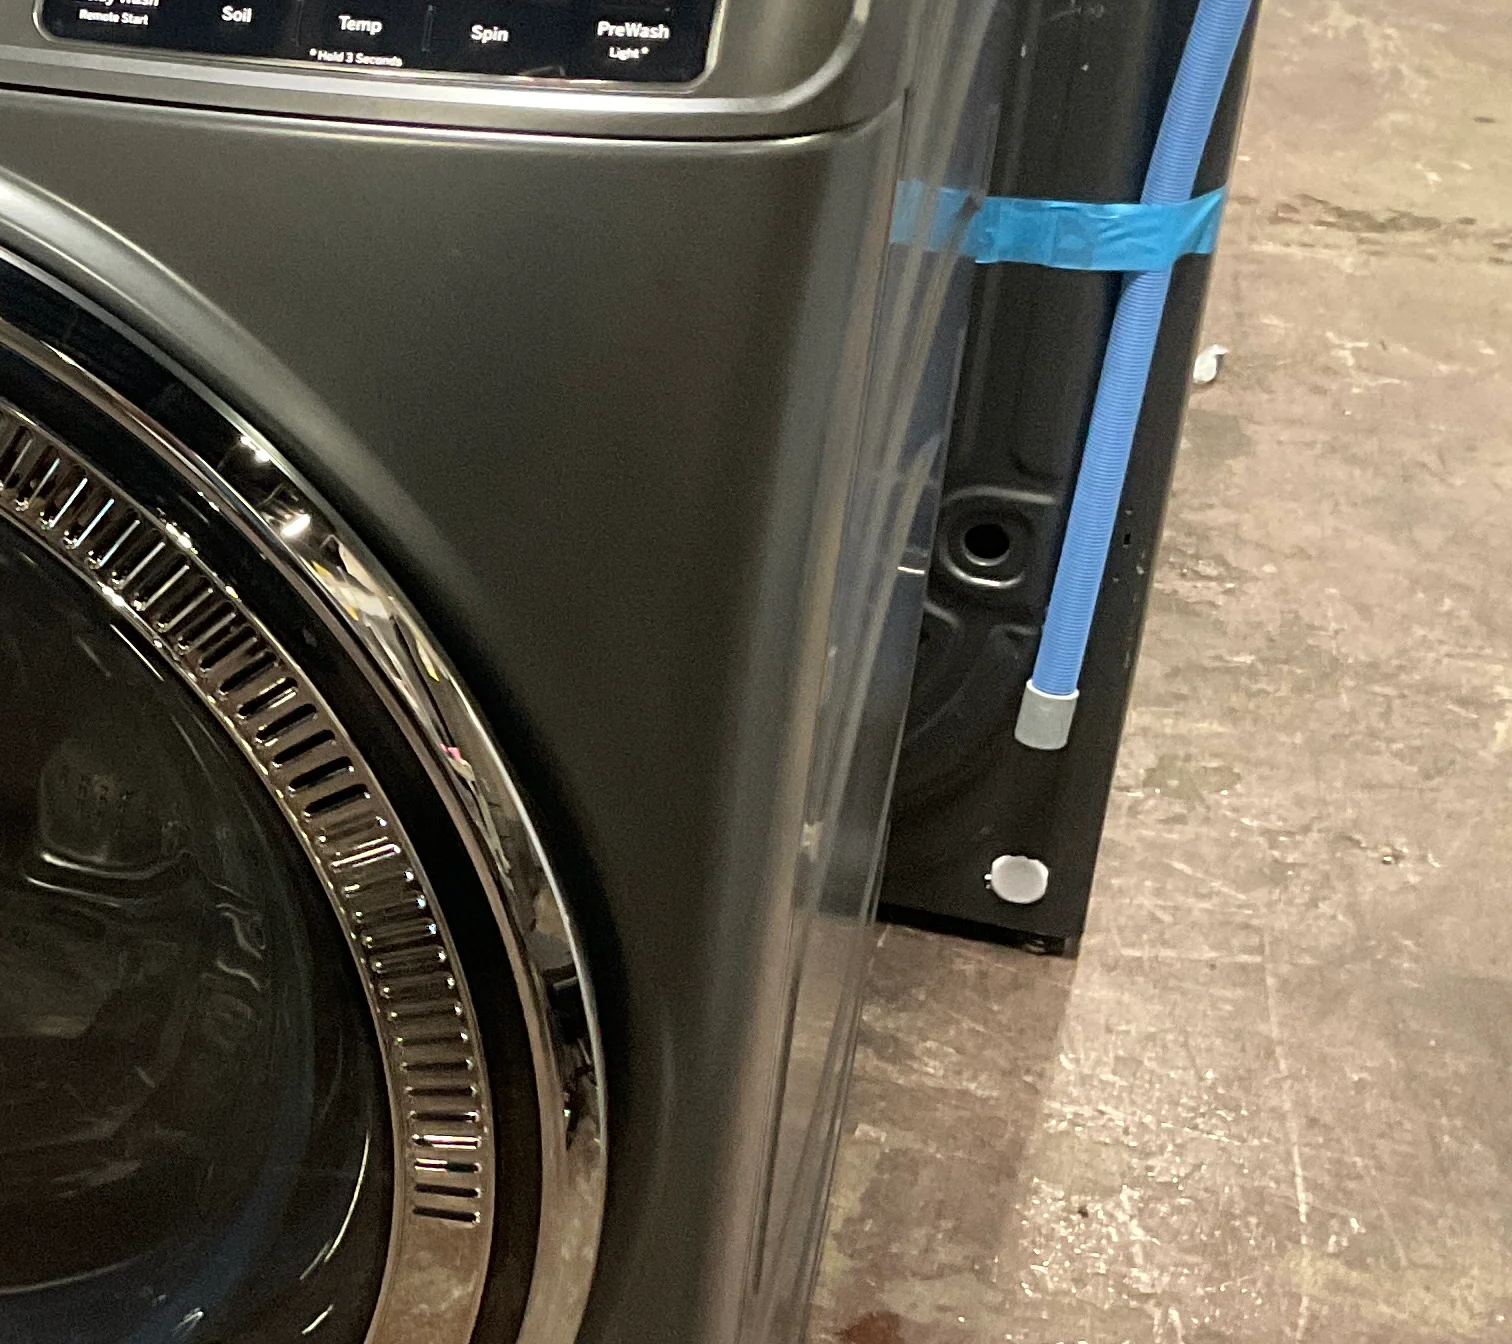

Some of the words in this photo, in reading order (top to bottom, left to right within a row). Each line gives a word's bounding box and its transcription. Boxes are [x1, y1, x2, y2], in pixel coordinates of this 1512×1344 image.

[78, 8, 121, 24] Remote
[120, 11, 150, 26] Start
[220, 5, 253, 24] Soil
[338, 14, 384, 37] Temp
[470, 23, 510, 44] Spin
[596, 20, 671, 40] PreWash
[355, 51, 404, 68] Seconds
[608, 46, 640, 62] Light
